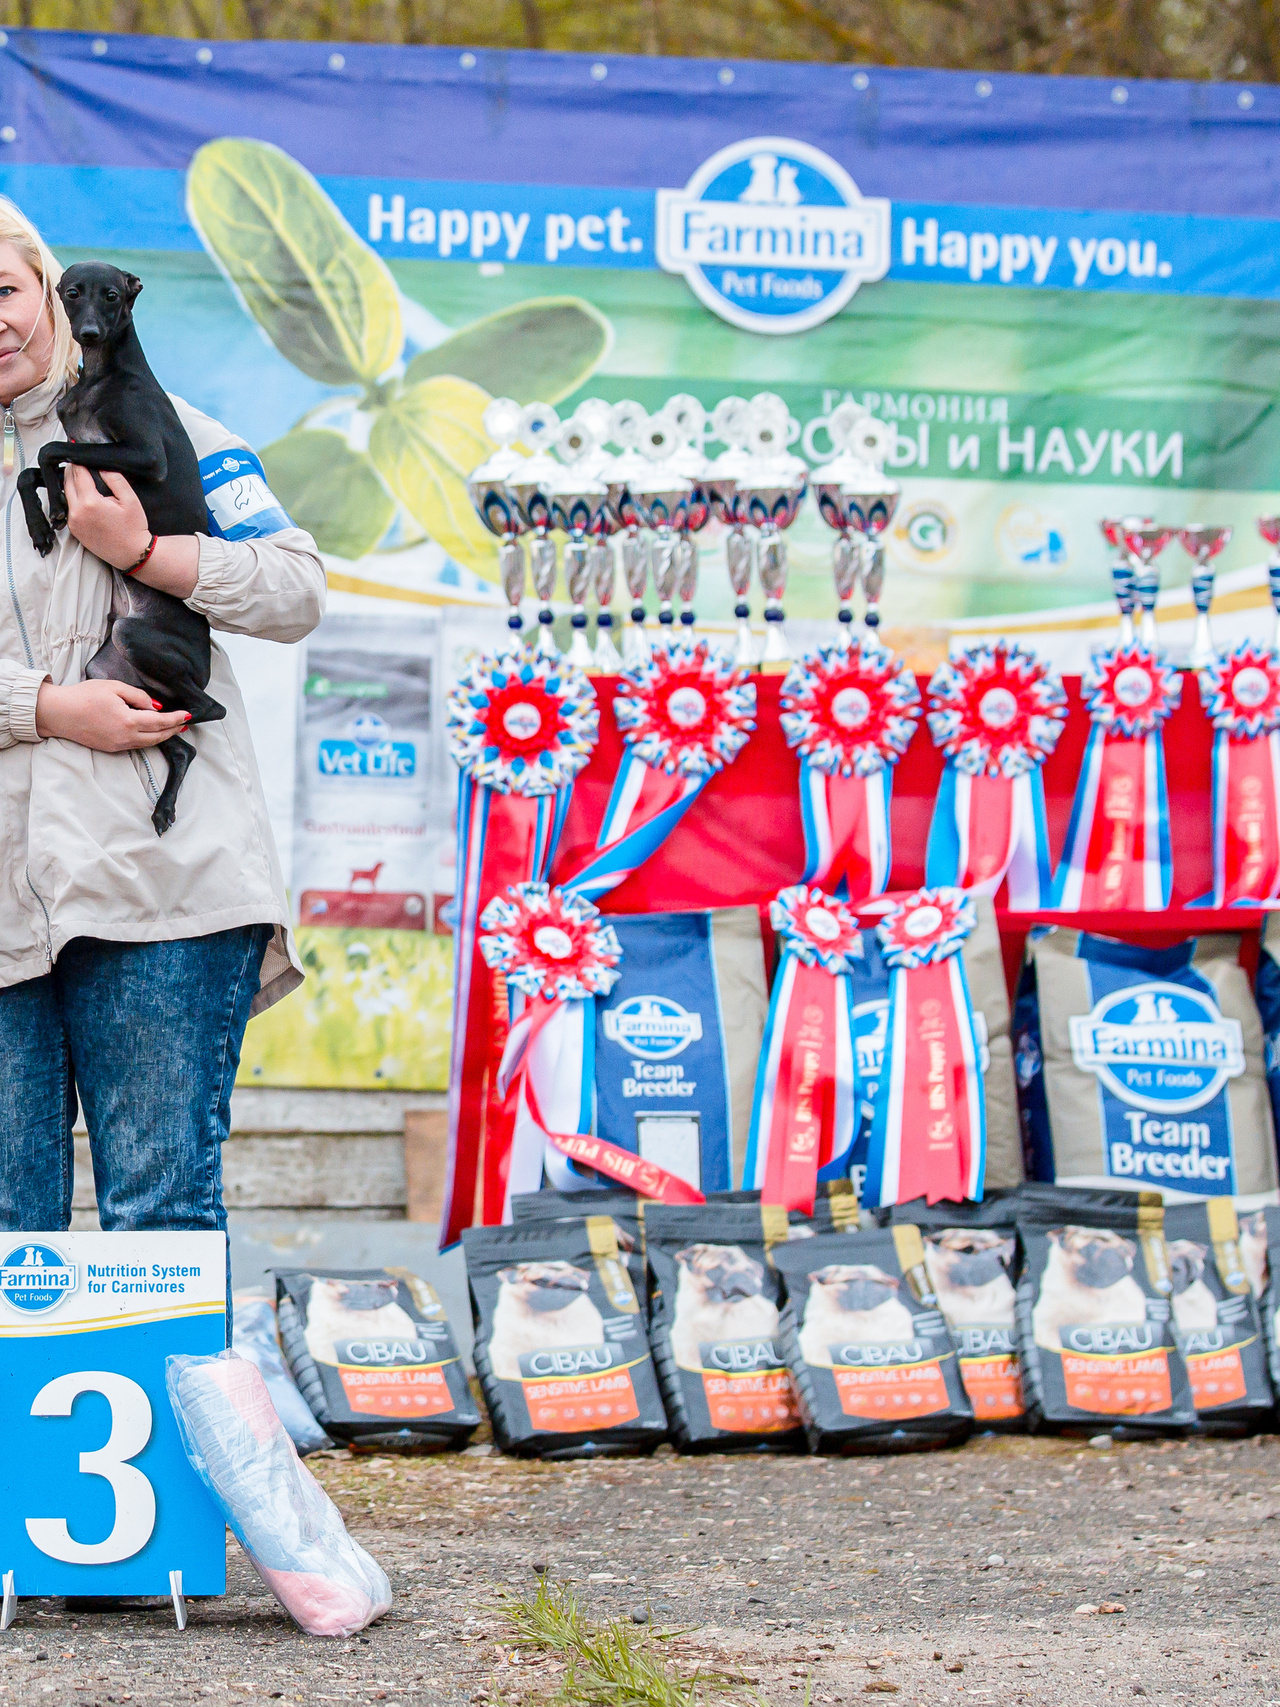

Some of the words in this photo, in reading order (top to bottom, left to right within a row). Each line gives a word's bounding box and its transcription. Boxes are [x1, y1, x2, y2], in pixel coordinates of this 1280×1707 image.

[369, 193, 531, 260] Happy
[545, 207, 643, 262] pet.
[683, 211, 863, 258] Farmina
[901, 216, 1058, 285] Happy
[1067, 237, 1172, 286] you.
[722, 270, 757, 298] Pet
[761, 271, 824, 300] Foods
[998, 425, 1185, 480] НАУКИ
[615, 1017, 691, 1033] Farmina
[1091, 1027, 1228, 1061] Farmina
[630, 1060, 685, 1080] Team
[1126, 1068, 1153, 1087] Pet
[1155, 1069, 1204, 1088] Foods
[622, 1077, 697, 1098] Breeder
[1124, 1111, 1211, 1149] Team
[1110, 1142, 1231, 1180] Breeder
[87, 1264, 147, 1277] Nutrition
[151, 1264, 201, 1280] System
[14, 1293, 27, 1302] Pet
[29, 1293, 53, 1302] Foods
[88, 1280, 106, 1293] for
[111, 1280, 186, 1293] Carnivores
[1069, 1325, 1153, 1351] CIBAU
[346, 1340, 427, 1364] CIBAU
[529, 1346, 613, 1376] CIBAU
[838, 1340, 923, 1367] CIBAU
[342, 1371, 406, 1386] SENSITIVE
[407, 1371, 444, 1385] LAMB
[526, 1380, 589, 1400] SENSITIVE
[589, 1375, 630, 1394] LAMB
[25, 1370, 157, 1565] 3
